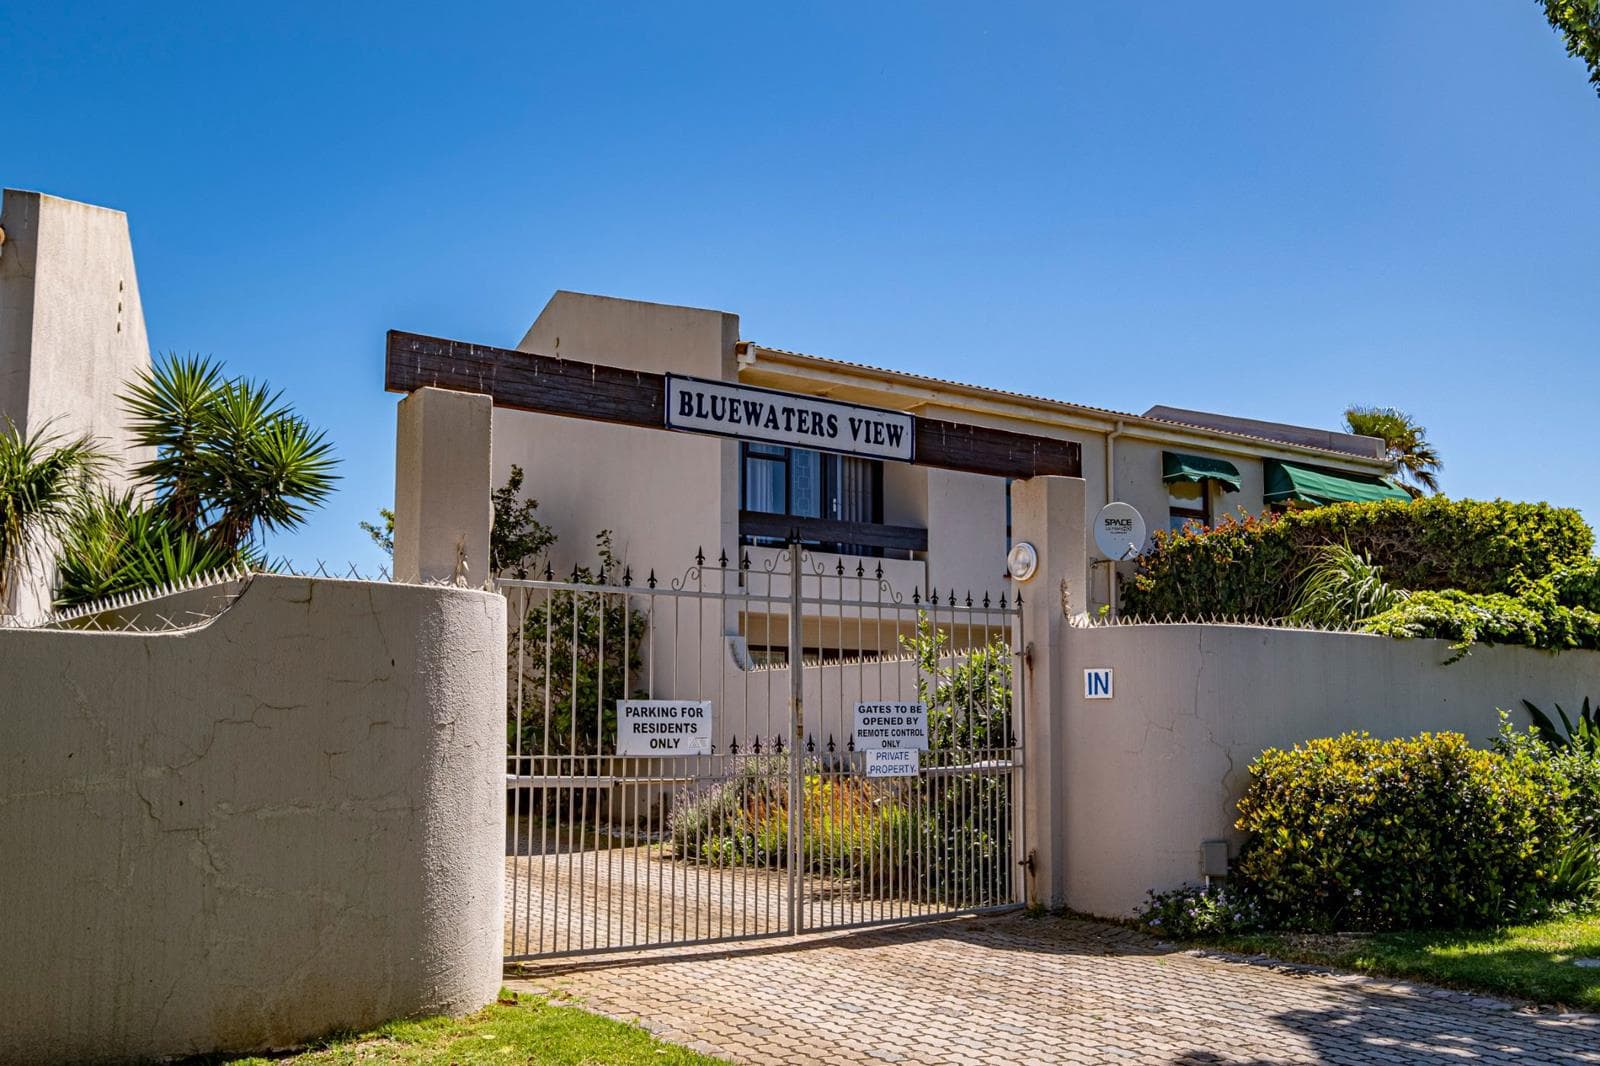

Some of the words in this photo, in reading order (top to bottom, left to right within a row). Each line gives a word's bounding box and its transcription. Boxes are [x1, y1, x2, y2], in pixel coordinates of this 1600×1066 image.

[679, 390, 839, 438] BLUEWATERS
[848, 417, 904, 448] VIEW
[1087, 671, 1109, 696] IN
[625, 707, 677, 717] PARKING
[681, 707, 703, 717] FOR
[858, 705, 892, 714] GATES
[894, 705, 907, 714] TO
[910, 705, 922, 714] BE
[862, 717, 903, 725] OPENED
[906, 717, 919, 725] BY
[633, 723, 697, 733] RESIDENTS
[857, 729, 889, 737] REMOTE
[891, 729, 924, 737] CONTROL
[650, 738, 680, 748] ONLY
[881, 740, 900, 748] ONLY
[876, 752, 909, 760] PRIVATE
[870, 764, 914, 774] PROPERTY
